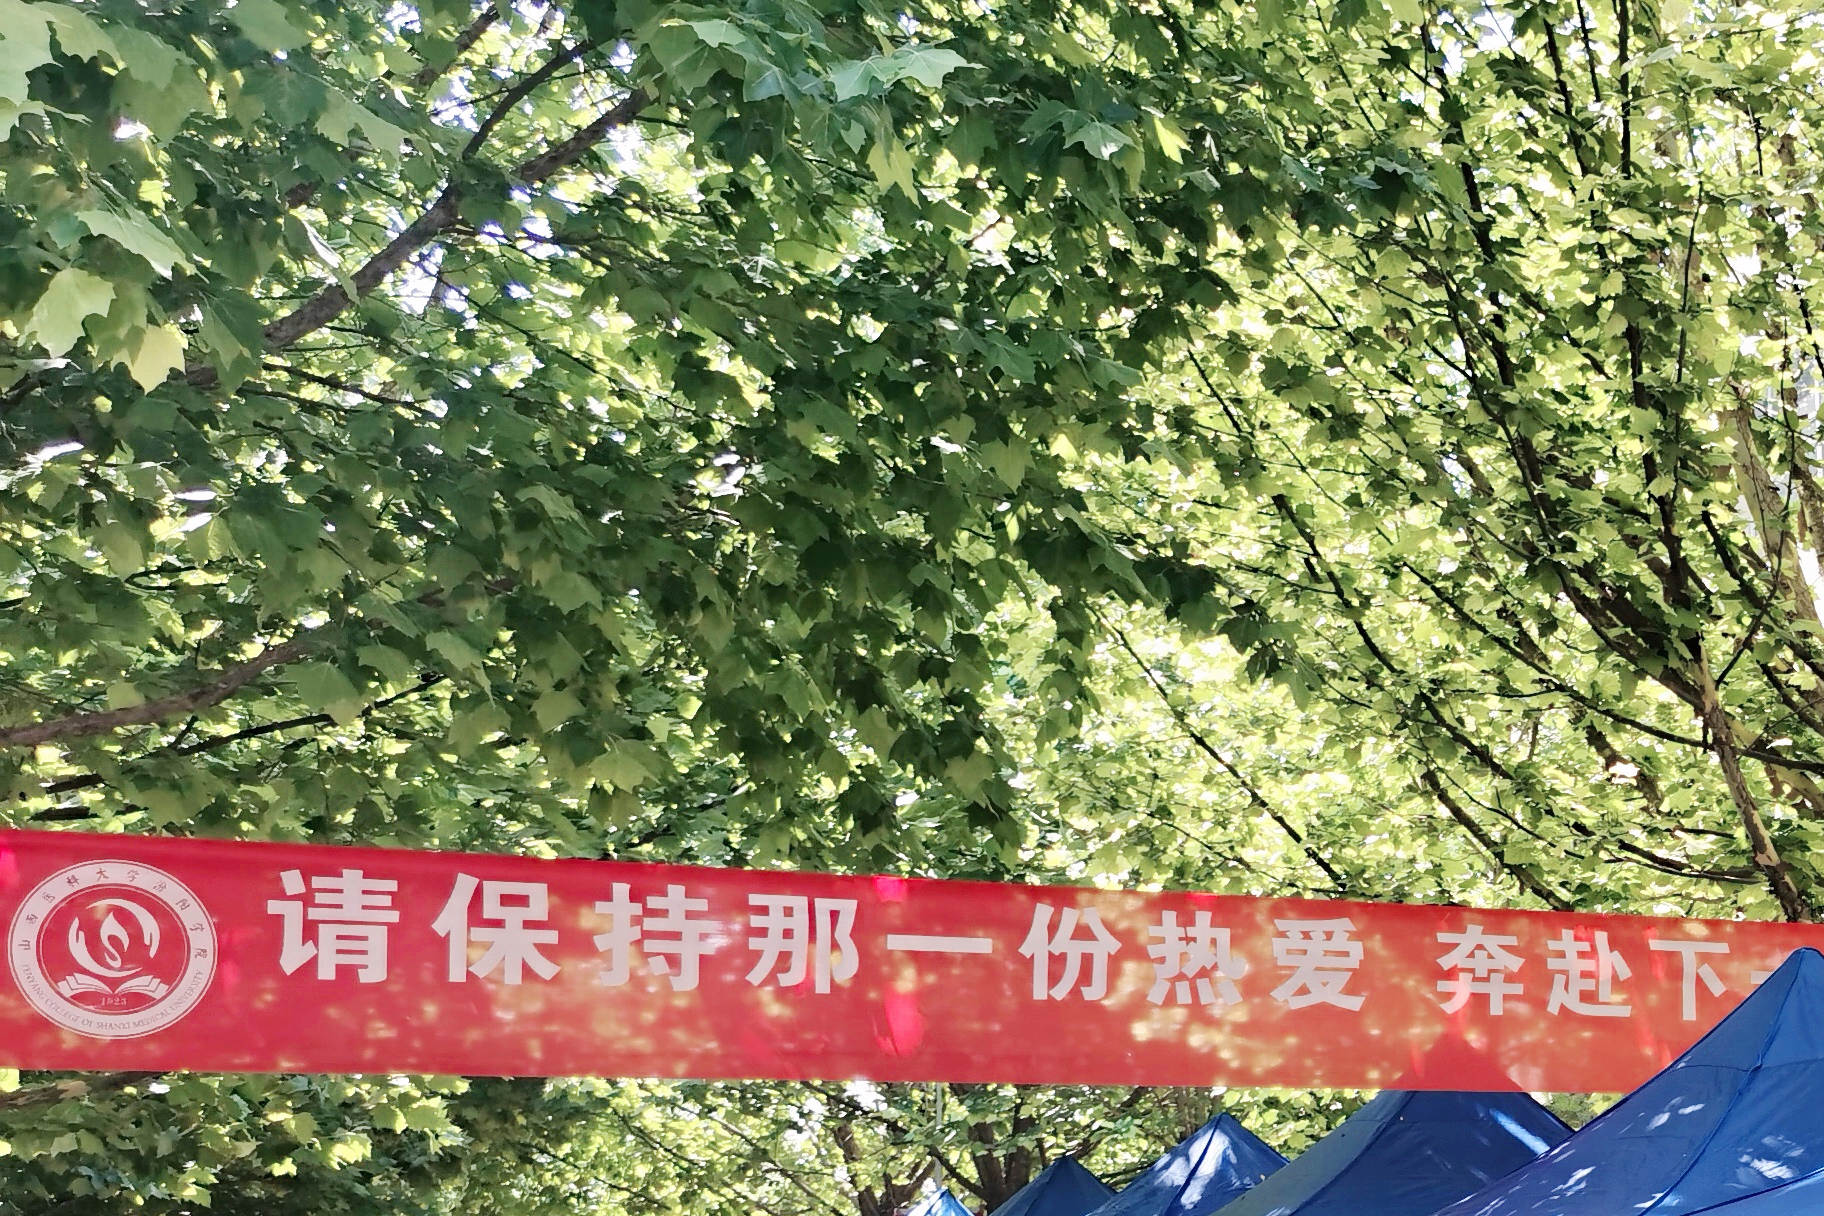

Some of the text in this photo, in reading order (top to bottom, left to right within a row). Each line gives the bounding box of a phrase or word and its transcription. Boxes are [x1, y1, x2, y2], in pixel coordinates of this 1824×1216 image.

[266, 869, 1366, 1010] 请保持那一份热爱
